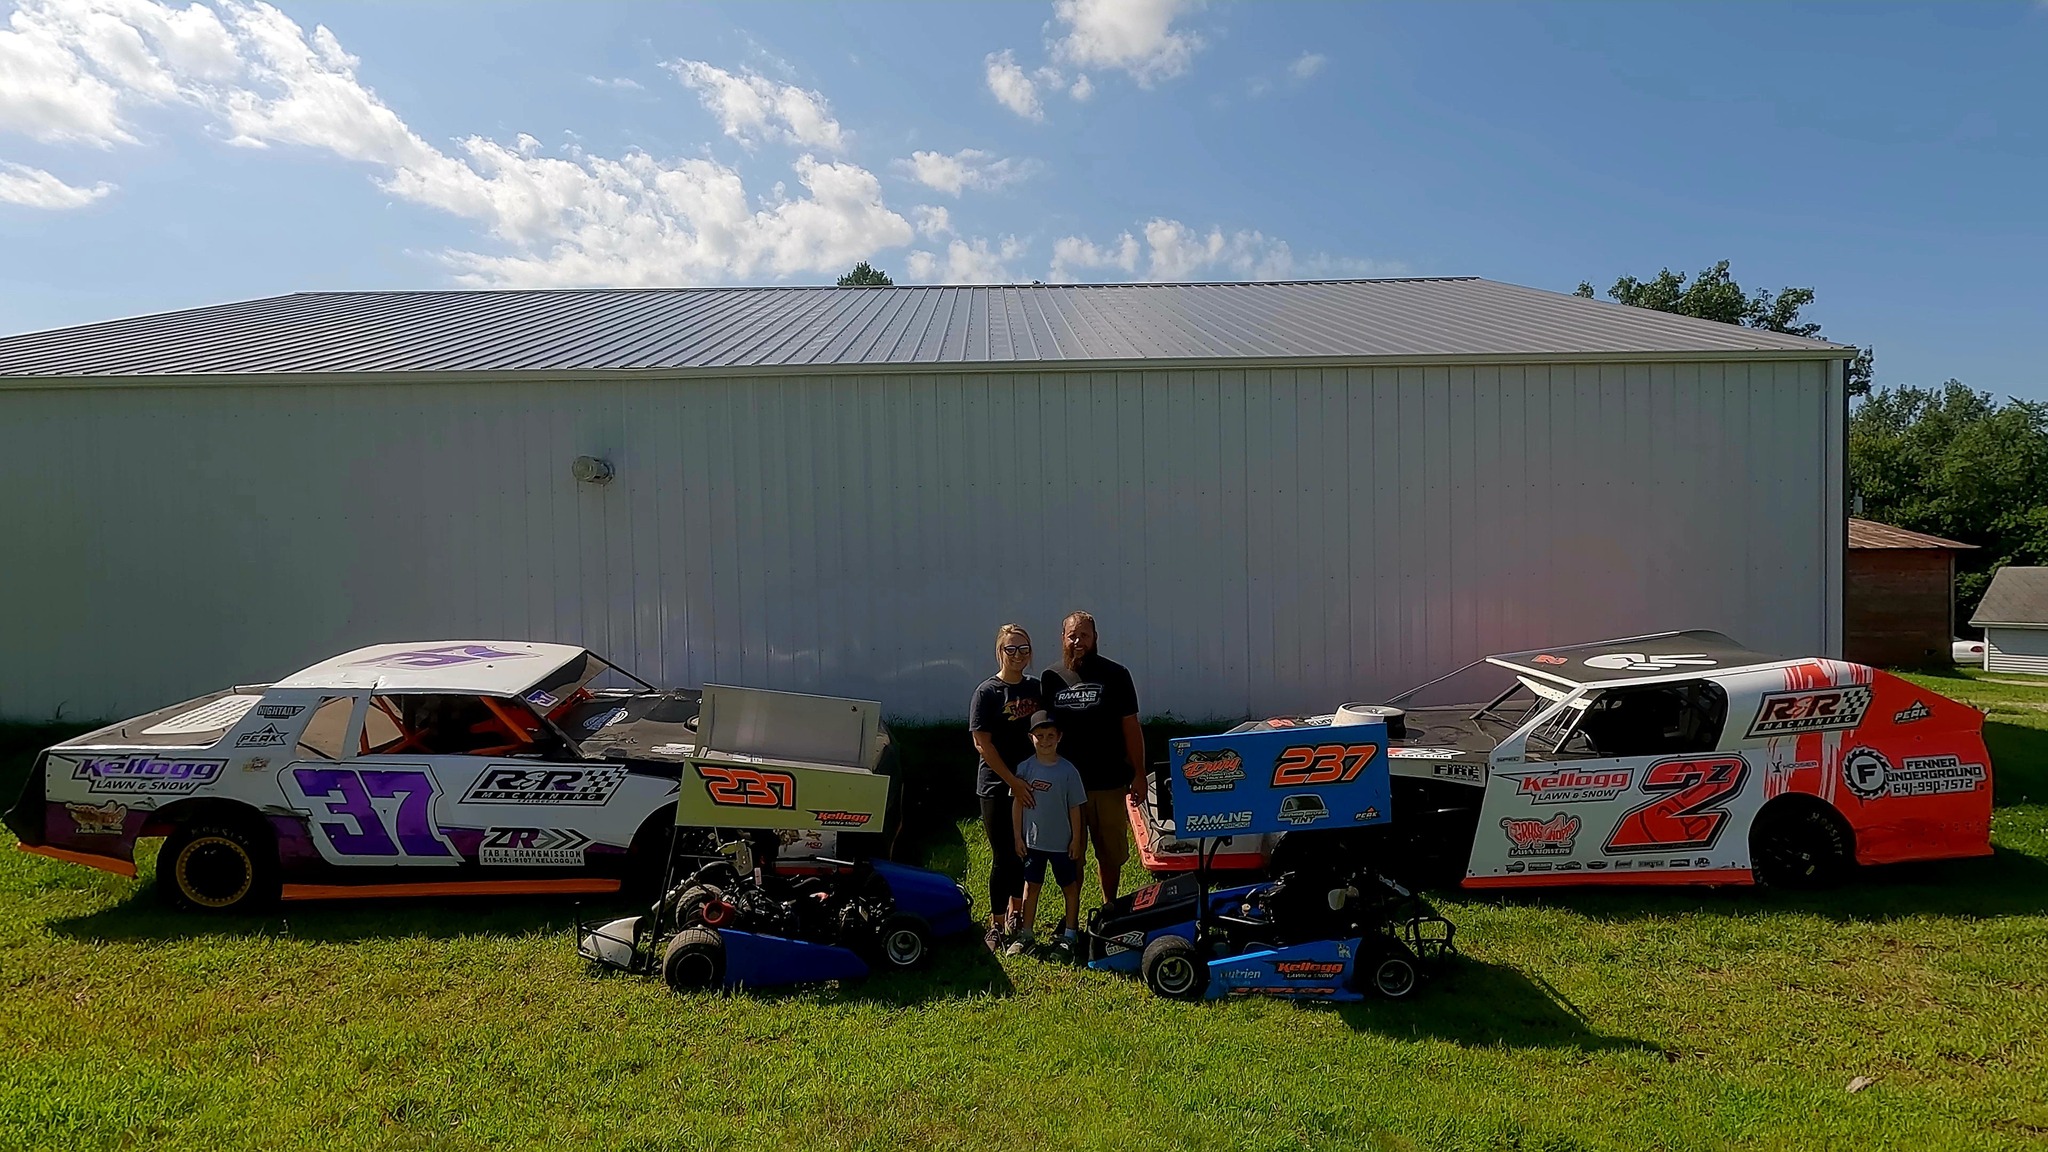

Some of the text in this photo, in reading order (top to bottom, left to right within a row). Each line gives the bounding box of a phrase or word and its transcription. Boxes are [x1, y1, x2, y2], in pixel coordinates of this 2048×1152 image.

[1894, 708, 1929, 721] PEAK
[1763, 716, 1852, 730] MACHINING
[240, 734, 280, 743] PEAK
[80, 758, 219, 780] Kellogg
[1272, 744, 1377, 786] 237
[1906, 757, 1957, 770] FENNER
[1857, 763, 1877, 784] F
[1885, 766, 1983, 783] UNDERGROUND
[96, 780, 136, 790] LAWN
[149, 781, 196, 790] SNOW
[698, 764, 794, 808] 237
[1522, 772, 1629, 791] Kellogg
[481, 791, 597, 800] MACHINING
[1537, 791, 1570, 800] LAWN
[1581, 789, 1616, 799] SNOW
[292, 768, 455, 857] 37
[817, 811, 871, 823] Kellogg
[1186, 811, 1253, 826] RAWLINS
[1355, 811, 1378, 820] PEAK
[1291, 816, 1315, 824] TINT
[483, 827, 540, 849] ZR
[483, 849, 500, 857] FAB
[513, 849, 580, 858] TRANSMISSION
[1277, 961, 1344, 973] Kellogg
